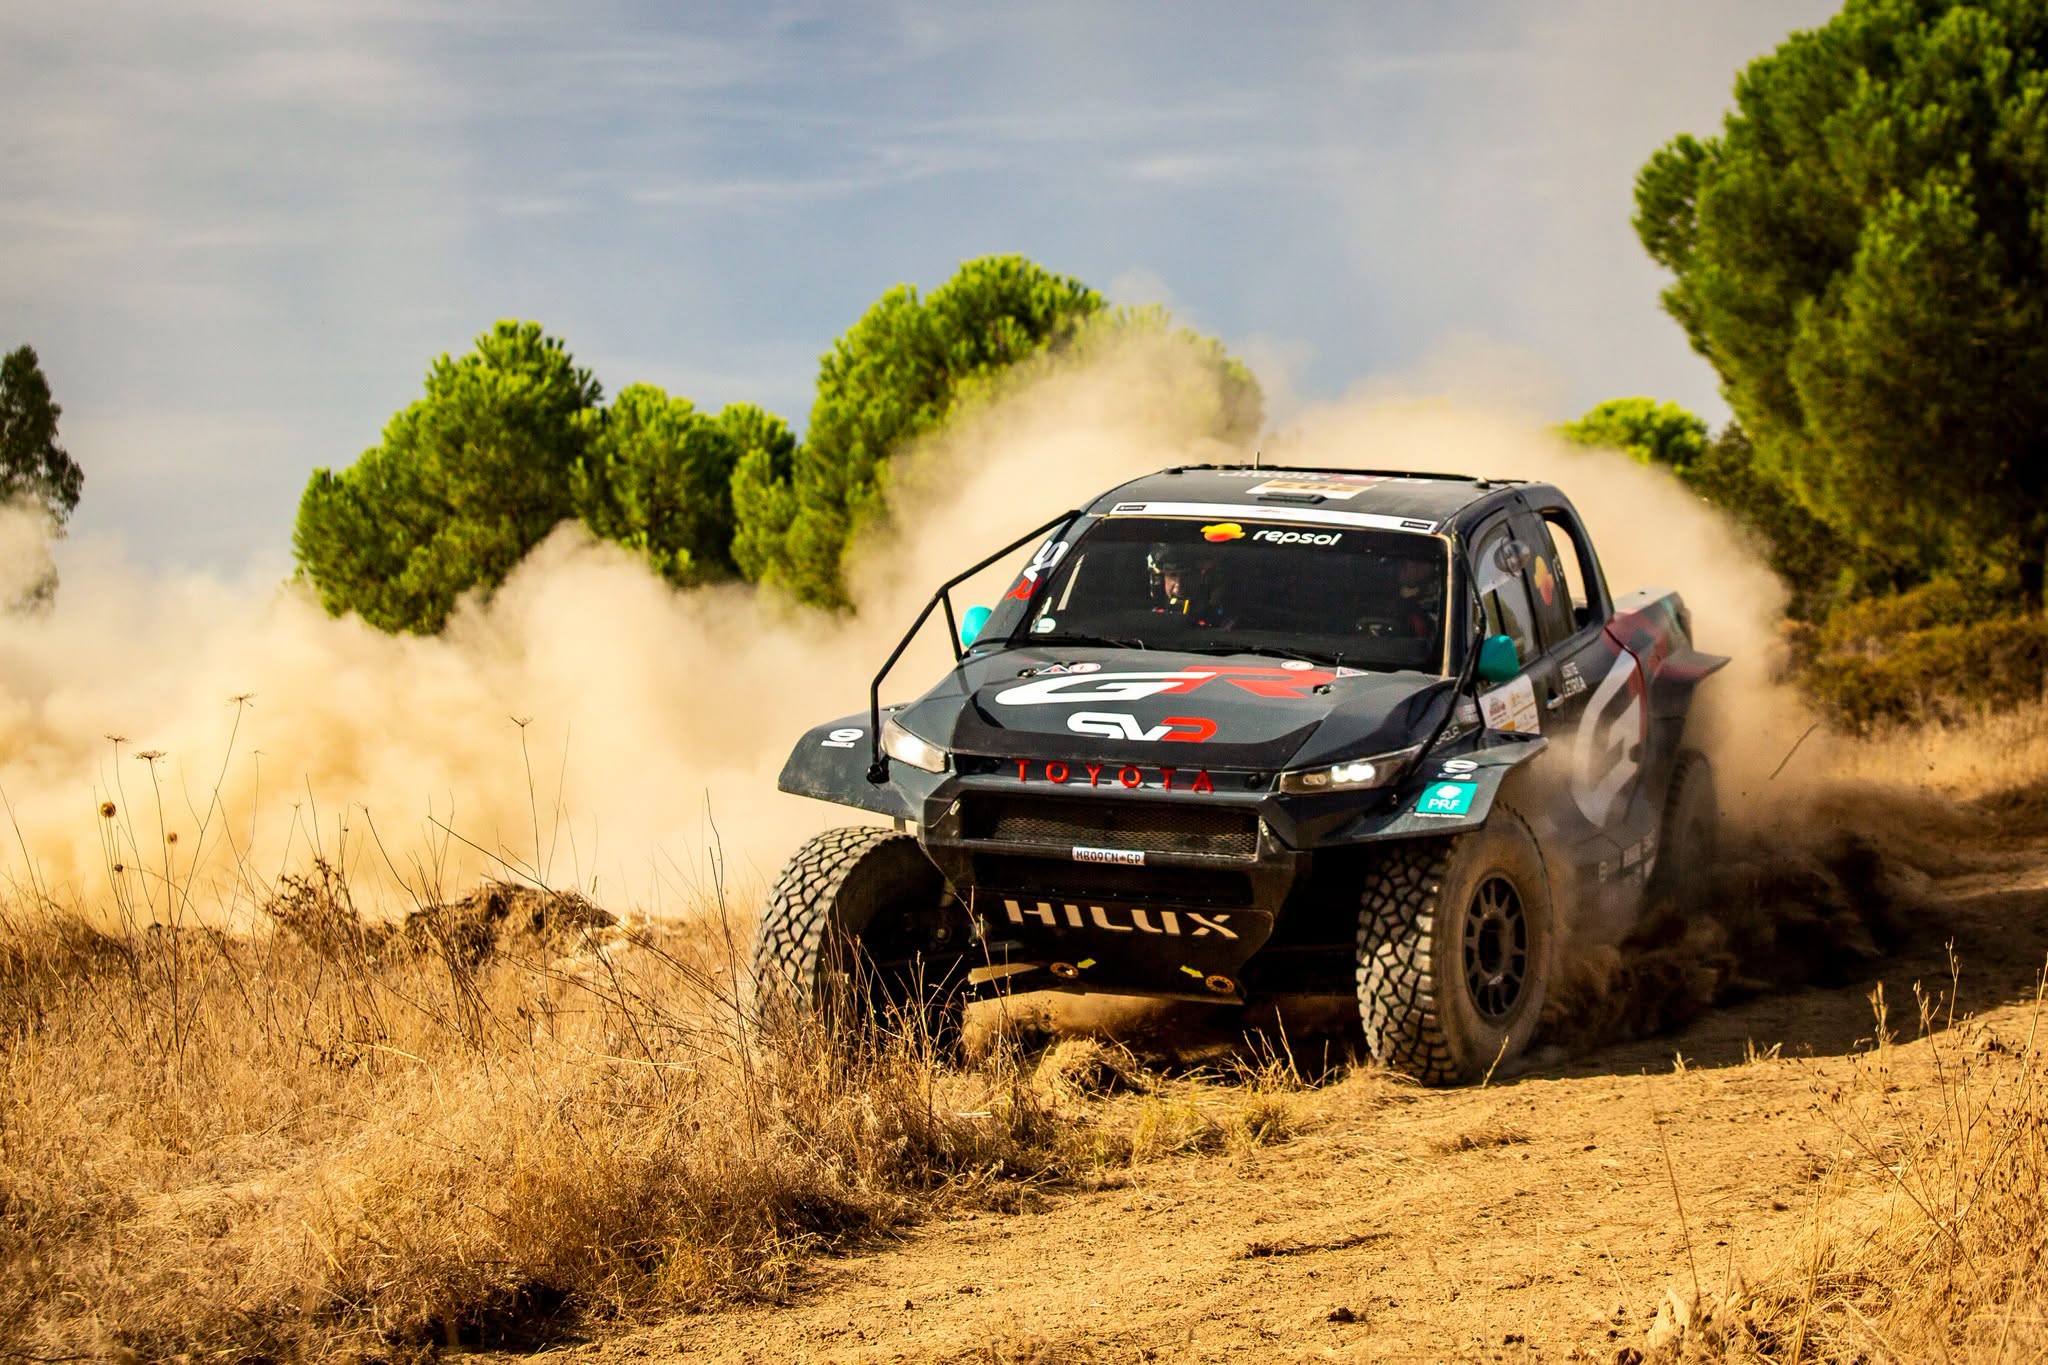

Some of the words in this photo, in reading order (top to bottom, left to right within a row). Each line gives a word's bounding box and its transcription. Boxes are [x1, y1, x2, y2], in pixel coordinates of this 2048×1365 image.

[1252, 529, 1342, 546] repsol
[995, 665, 1336, 705] GR
[1014, 759, 1214, 792] TOYOTA
[1427, 798, 1462, 811] PRF
[1003, 900, 1239, 939] HILUX
